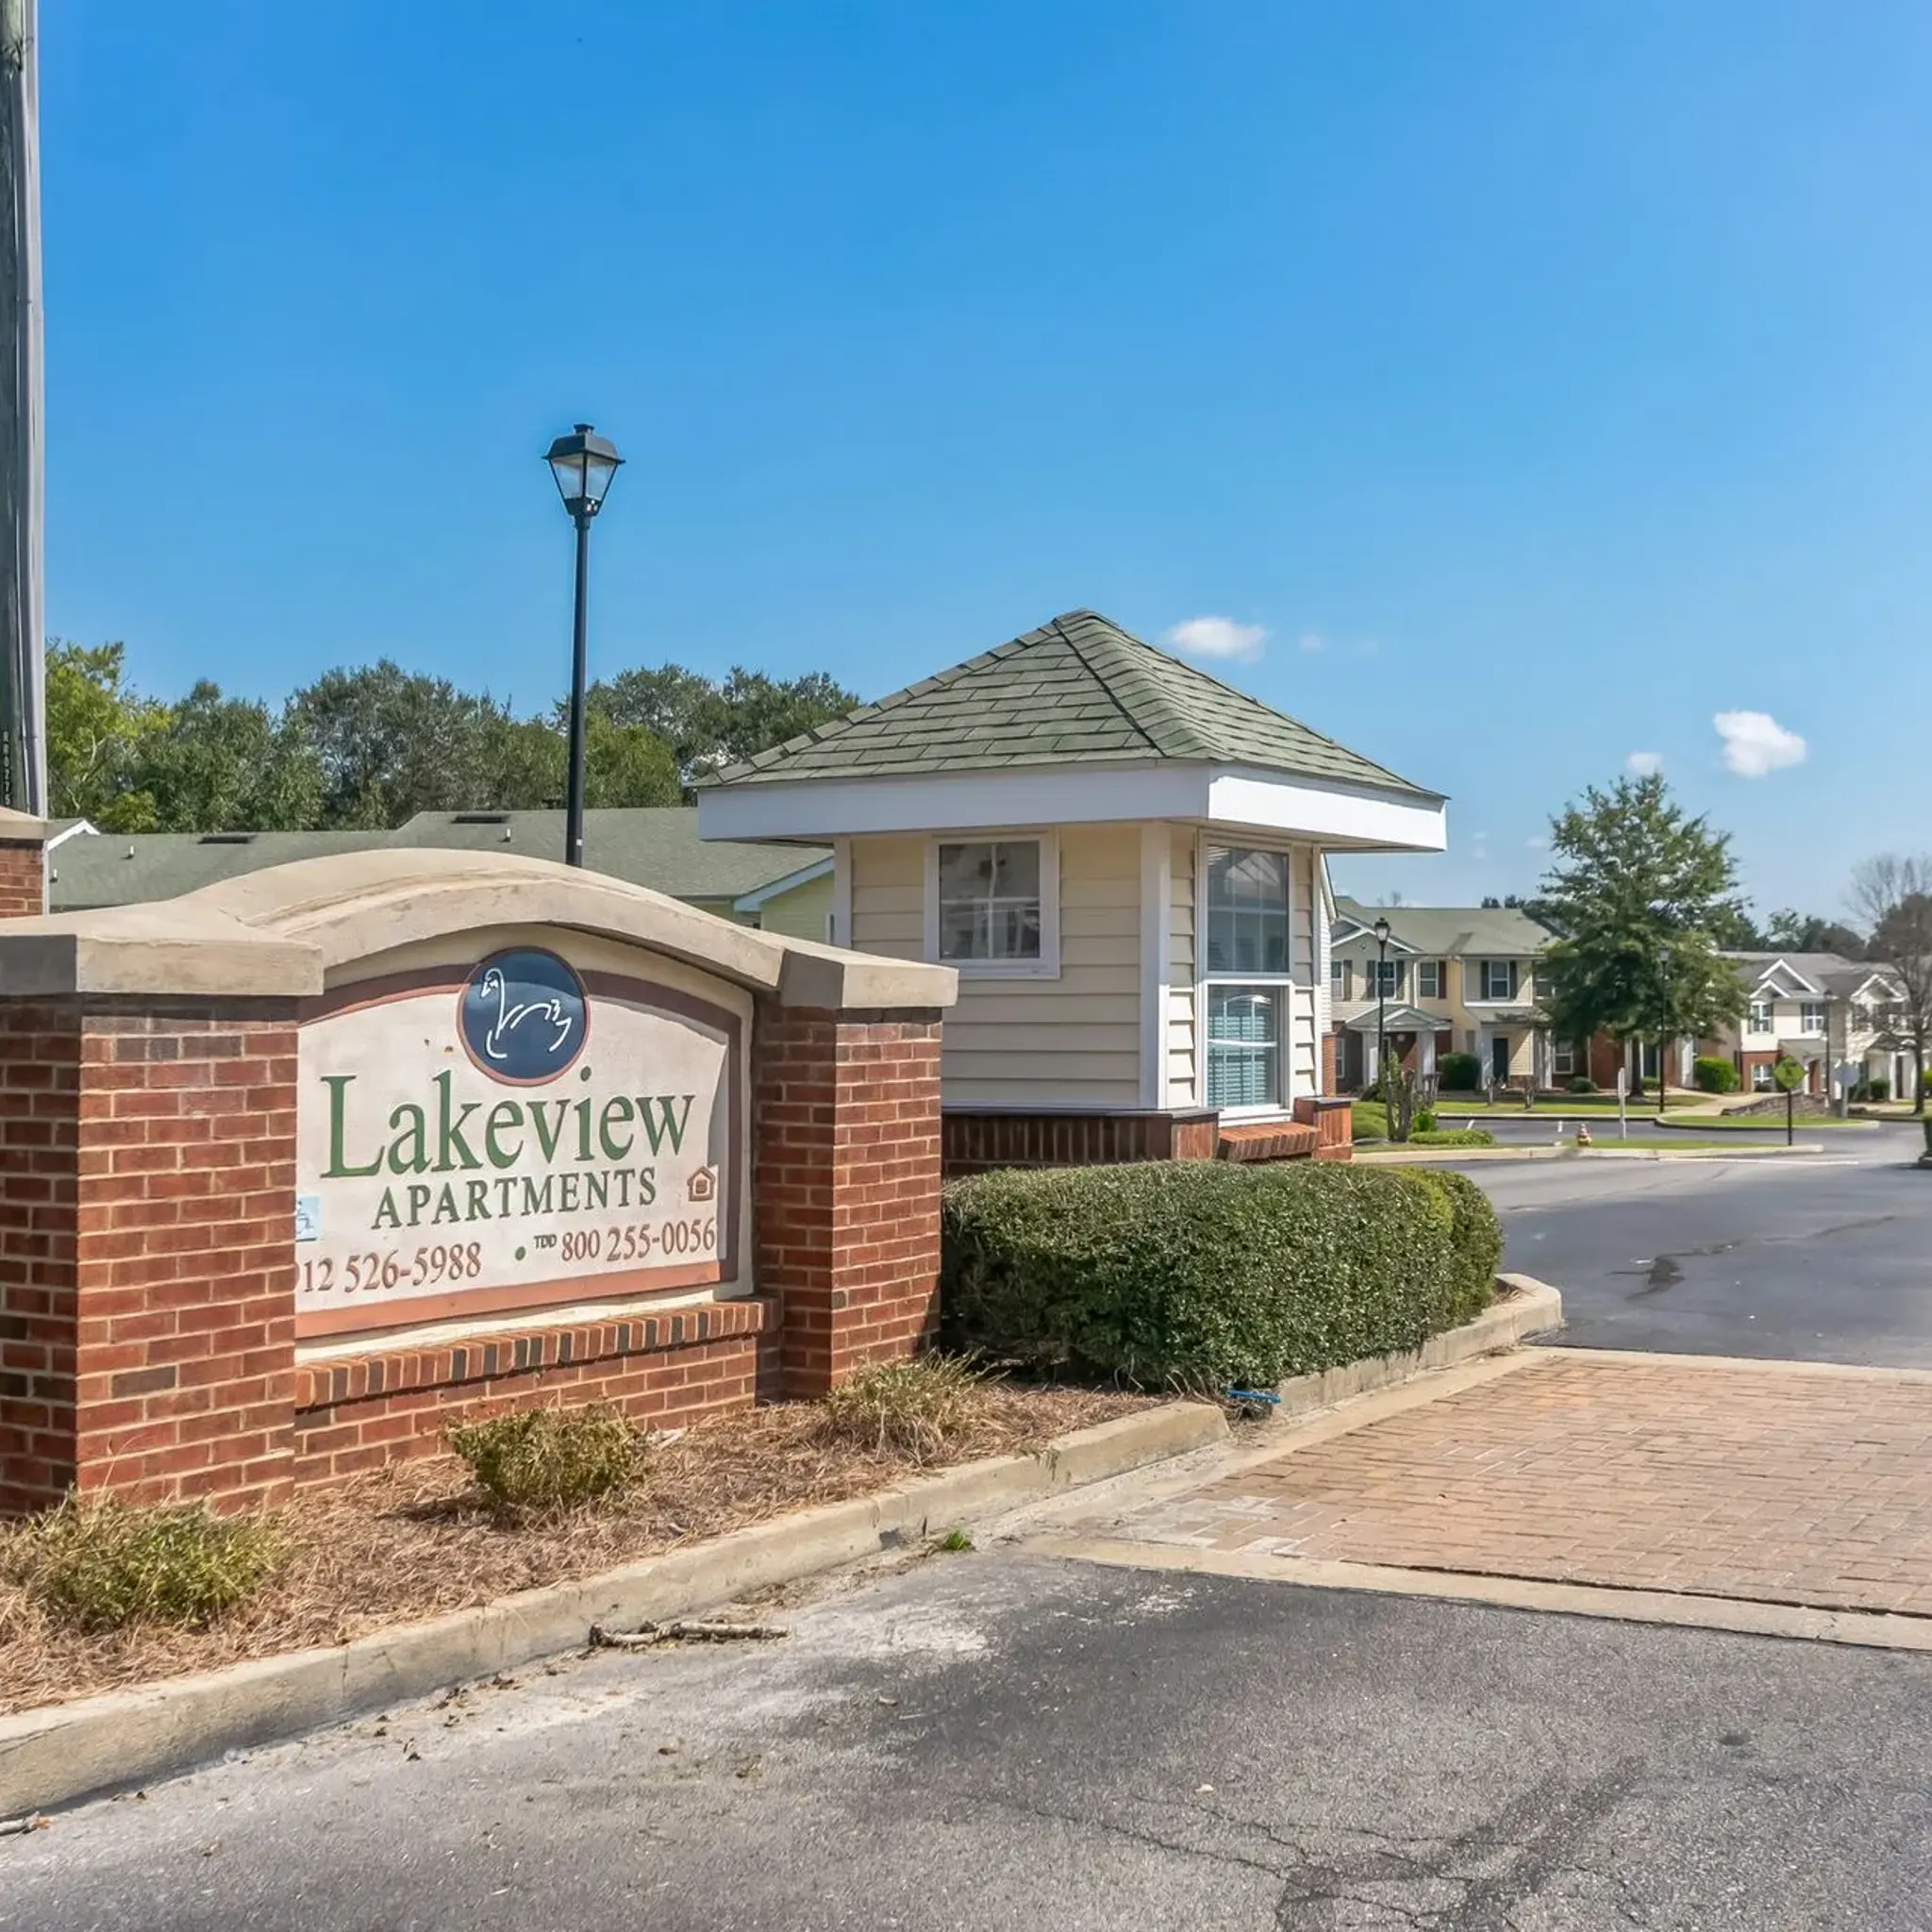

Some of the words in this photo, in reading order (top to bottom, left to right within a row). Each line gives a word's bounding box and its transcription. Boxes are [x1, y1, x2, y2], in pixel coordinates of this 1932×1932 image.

[320, 1066, 696, 1179] Lakeview
[371, 1166, 658, 1229] APARTMENTS
[294, 1257, 335, 1293] 12
[344, 1241, 482, 1293] 526-5988
[534, 1234, 558, 1250] TDD
[561, 1229, 601, 1262] 800
[607, 1217, 716, 1262] 255-0056
